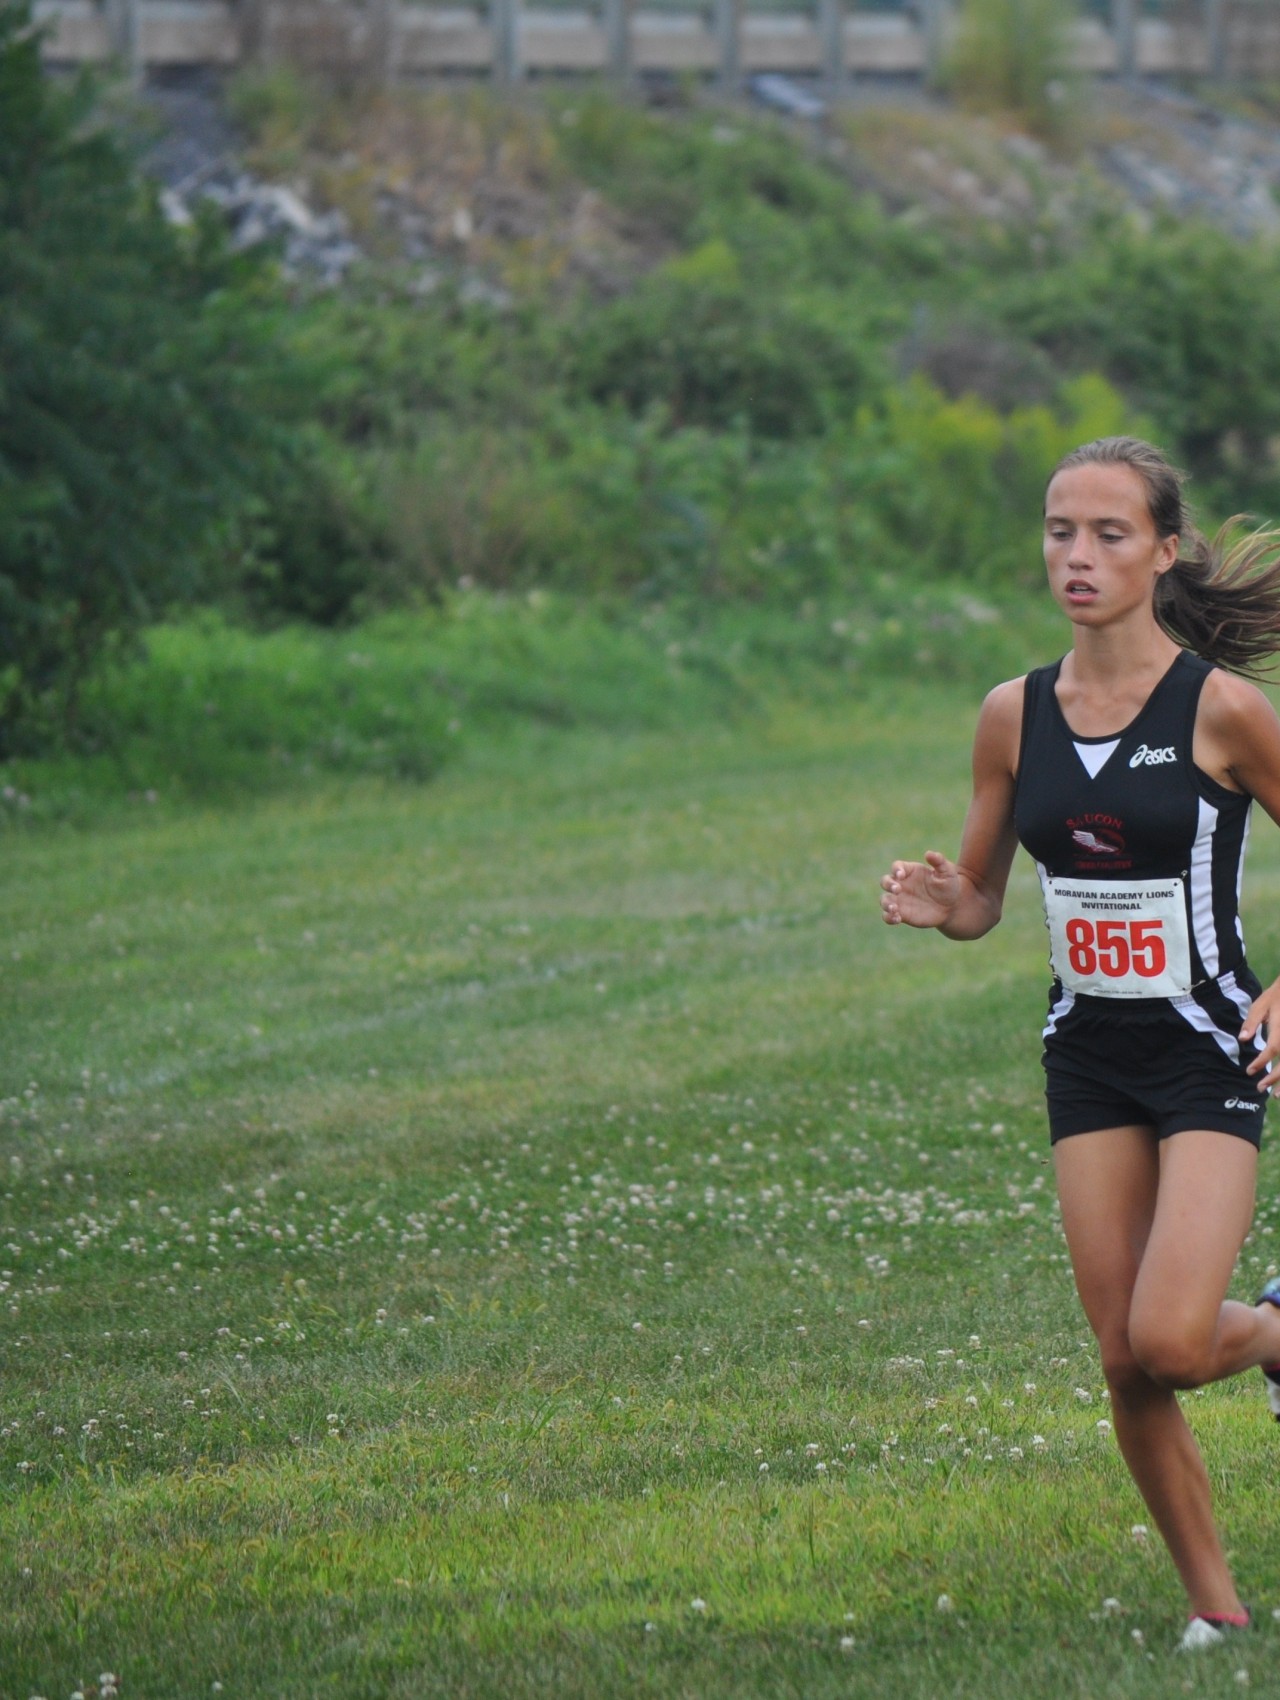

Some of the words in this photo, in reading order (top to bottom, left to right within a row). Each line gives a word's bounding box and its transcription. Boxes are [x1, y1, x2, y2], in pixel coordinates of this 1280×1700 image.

[1054, 889, 1098, 899] MORAVIAN
[1099, 891, 1143, 900] ACADEMY
[1146, 890, 1174, 899] LIONS
[1081, 902, 1142, 910] INVITATIONAL
[1066, 918, 1166, 978] 855
